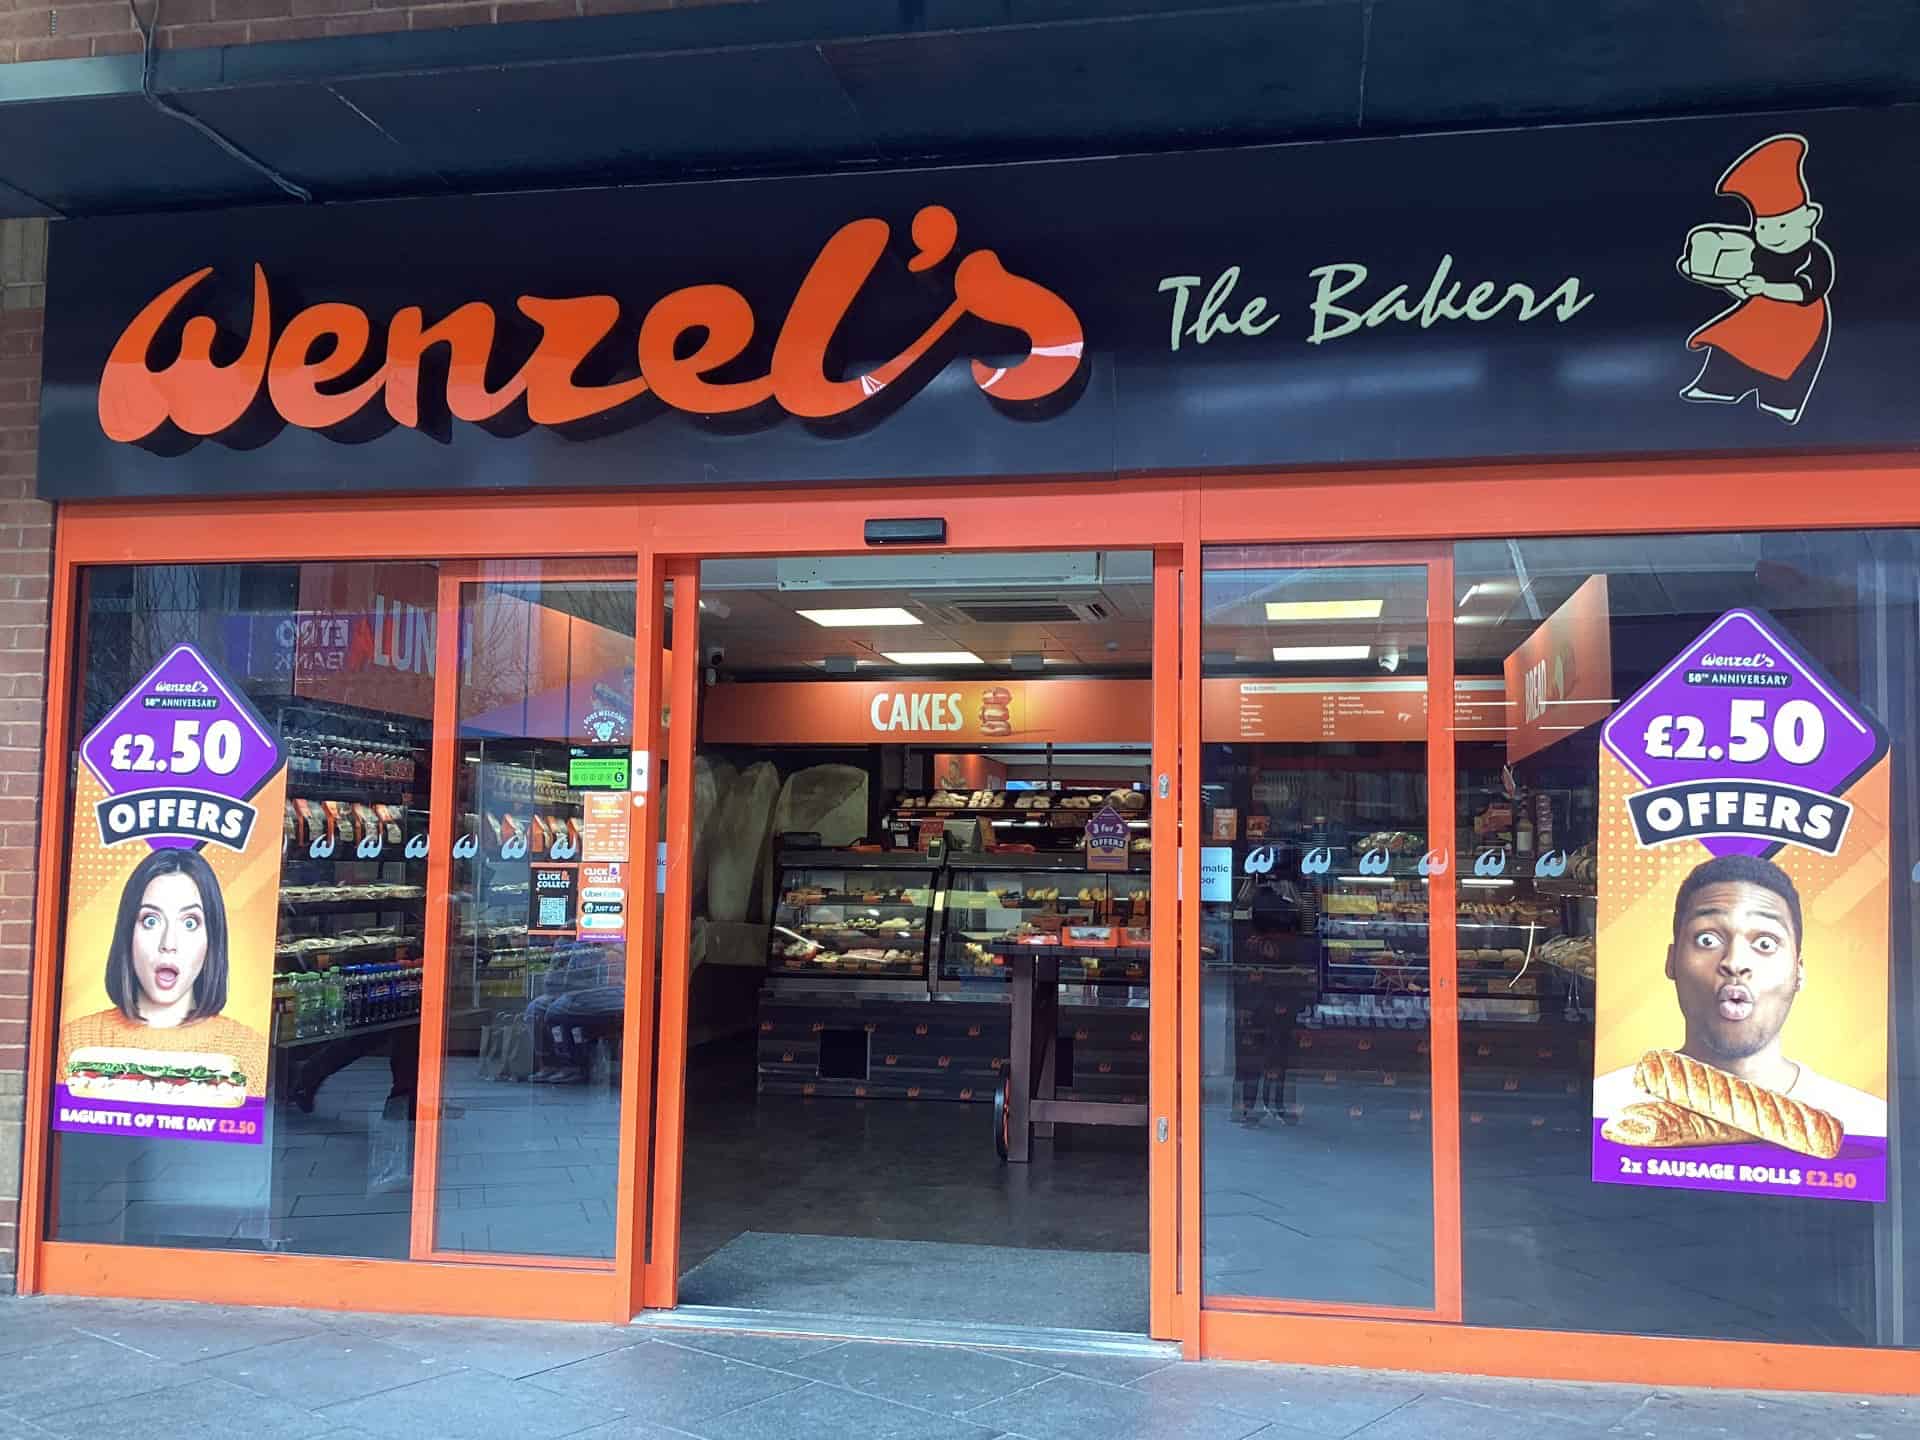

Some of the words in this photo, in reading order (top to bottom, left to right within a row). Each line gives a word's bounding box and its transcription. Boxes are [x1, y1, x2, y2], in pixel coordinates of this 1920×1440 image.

[1158, 265, 1281, 352] The
[1305, 253, 1596, 345] Bakers
[97, 204, 1084, 443] Wenzel's
[1700, 652, 1776, 668] Wenzel's
[154, 680, 209, 693] Wenzel's
[1711, 673, 1789, 686] ANNIVERSARY
[161, 697, 218, 708] ANNIVERSARY
[870, 691, 964, 732] CAKES
[1643, 698, 1827, 766] £2.50
[110, 719, 244, 775] £2.50
[107, 798, 244, 837] OFFERS
[1645, 790, 1835, 840] OFFERS
[1091, 837, 1125, 849] OFFERS
[583, 867, 609, 877] CLICK
[1201, 864, 1229, 873] matic
[536, 880, 570, 889] COLLECT
[537, 873, 561, 881] CLICK
[587, 875, 622, 884] COLLECT
[60, 1108, 132, 1128] BAGUETTE
[134, 1113, 154, 1128] OF
[157, 1114, 185, 1130] THE
[186, 1116, 217, 1133] DAY
[218, 1119, 256, 1135] £2.50
[1619, 1156, 1644, 1174] 2x
[1646, 1159, 1735, 1180] SAUSAGE
[1738, 1165, 1802, 1185] ROLLS
[1805, 1169, 1857, 1189] £2.50
